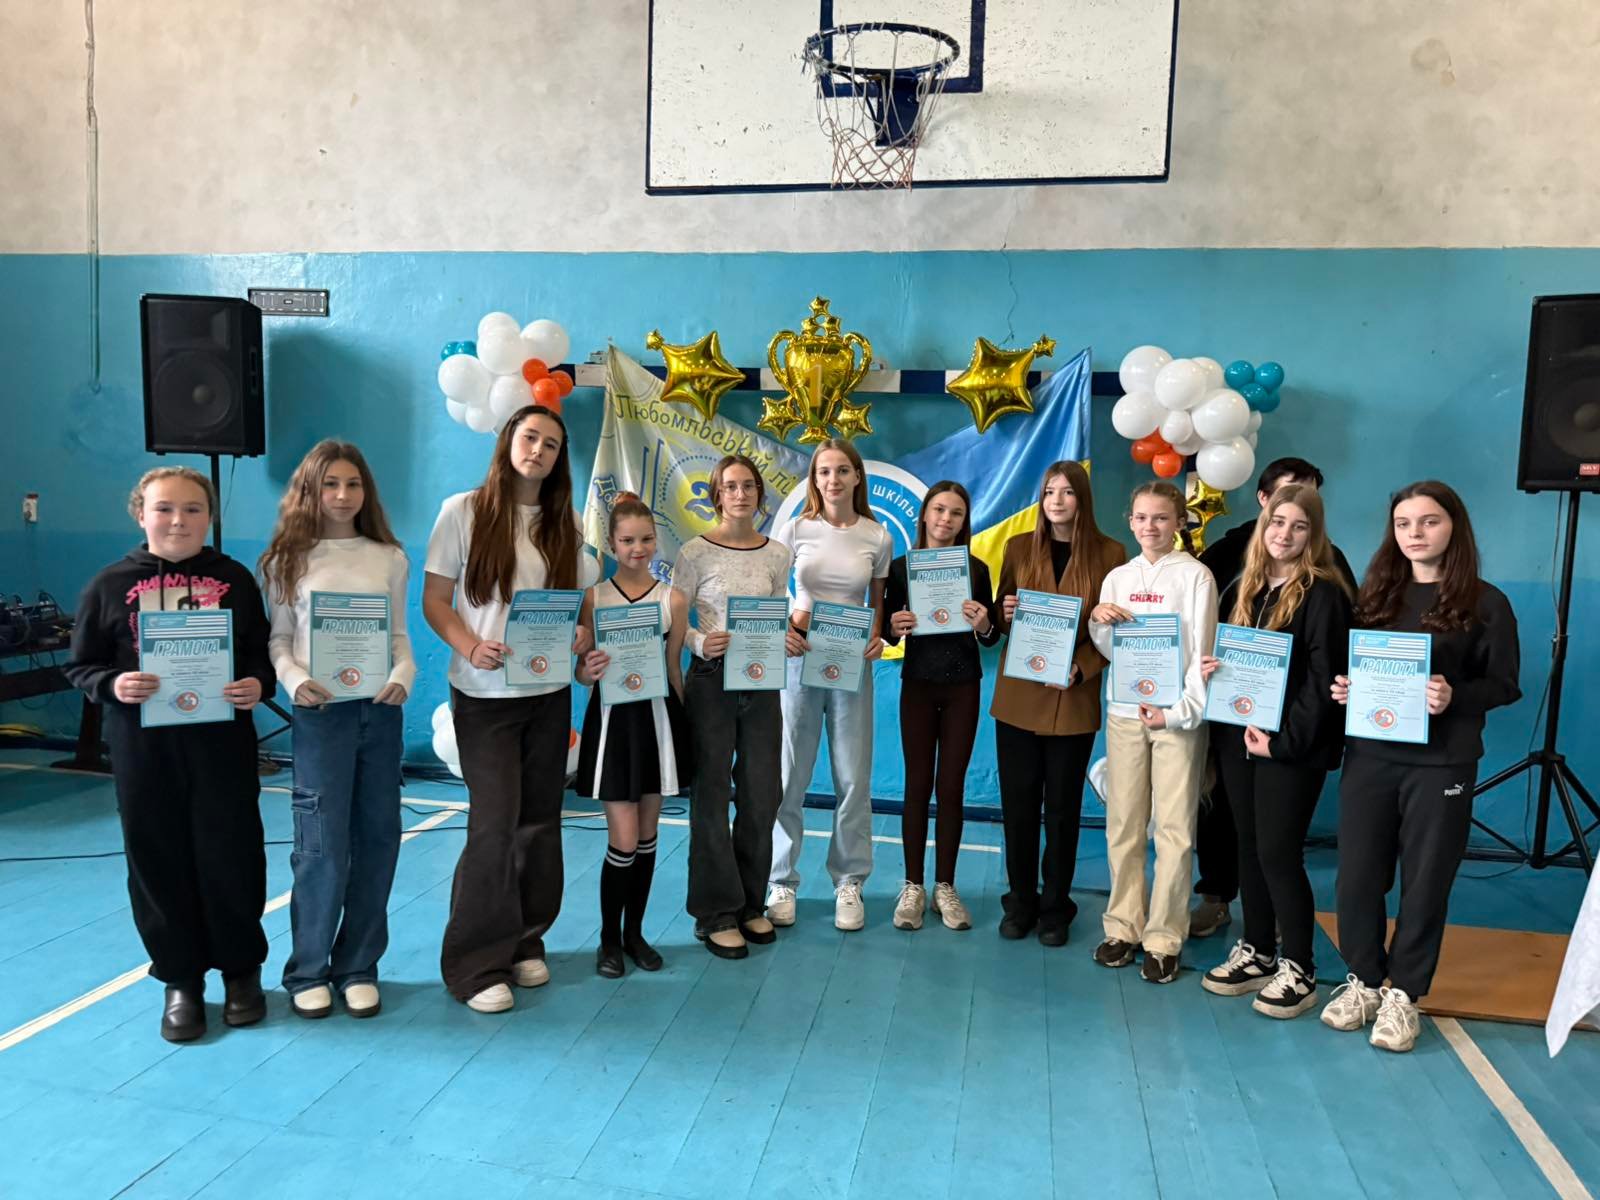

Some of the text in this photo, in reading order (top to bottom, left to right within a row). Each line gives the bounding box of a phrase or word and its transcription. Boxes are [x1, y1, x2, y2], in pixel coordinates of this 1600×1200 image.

[872, 484, 920, 527] ШКІЛЬ
[917, 567, 962, 583] ГРАМОТА
[1129, 593, 1165, 604] CHERRY
[321, 618, 380, 634] ГРАМОТА
[516, 611, 570, 625] ГРАМОТА
[735, 620, 780, 633] ГРАМОТА
[1022, 612, 1070, 632] ГРАМОТА
[606, 627, 654, 646] ГРАМОТА
[816, 623, 863, 640] ГРАМОТА
[153, 638, 221, 657] ГРАМОТА
[1121, 636, 1172, 651] ГРАМОТА
[1224, 649, 1280, 671] ГРАМОТА
[1360, 657, 1418, 677] ГРАМОТА
